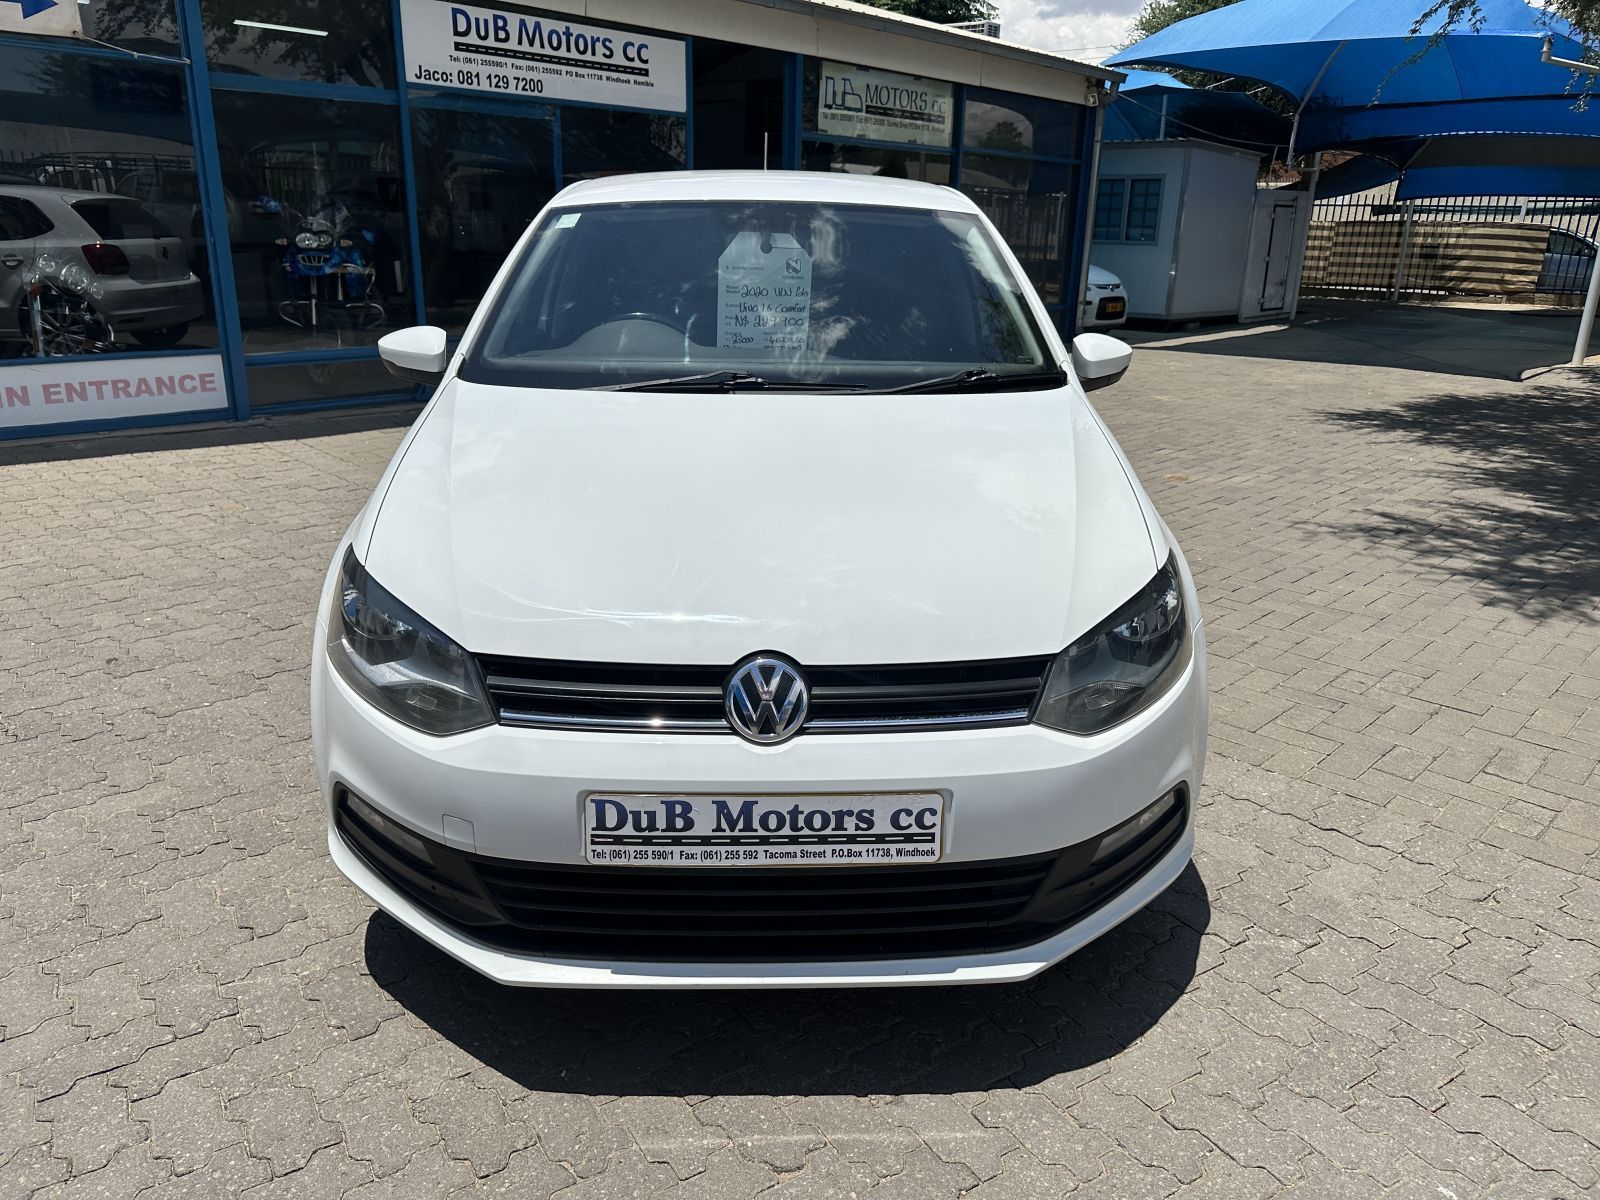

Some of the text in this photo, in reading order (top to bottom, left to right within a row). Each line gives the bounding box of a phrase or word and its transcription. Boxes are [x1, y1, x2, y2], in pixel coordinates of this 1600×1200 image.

[451, 7, 511, 43] DuB
[517, 18, 614, 59] Motors
[414, 64, 543, 94] Jaco: 081 129 7200
[449, 54, 461, 63] Tel:
[462, 56, 479, 67] (061)
[511, 62, 524, 71] Fax:
[525, 65, 541, 74] (061)
[565, 70, 574, 78] PO
[574, 71, 586, 79] Box
[605, 75, 631, 85] Windhoek
[865, 83, 929, 112] MOTORS
[741, 285, 769, 298] 2020
[41, 373, 217, 405] ENTRANCE
[590, 799, 938, 833] DuB Motors cc
[591, 849, 607, 860] Tel:
[609, 850, 631, 862] (061)
[633, 850, 649, 860] 255
[651, 850, 674, 861] 590/1
[679, 850, 698, 861] Fax:
[700, 850, 722, 862] (061)
[724, 850, 740, 860] 255
[742, 850, 759, 860] 592
[764, 849, 798, 860] Tacoma
[800, 848, 827, 859] Street
[866, 847, 894, 860] 11738,
[895, 847, 936, 858] Windhoek
